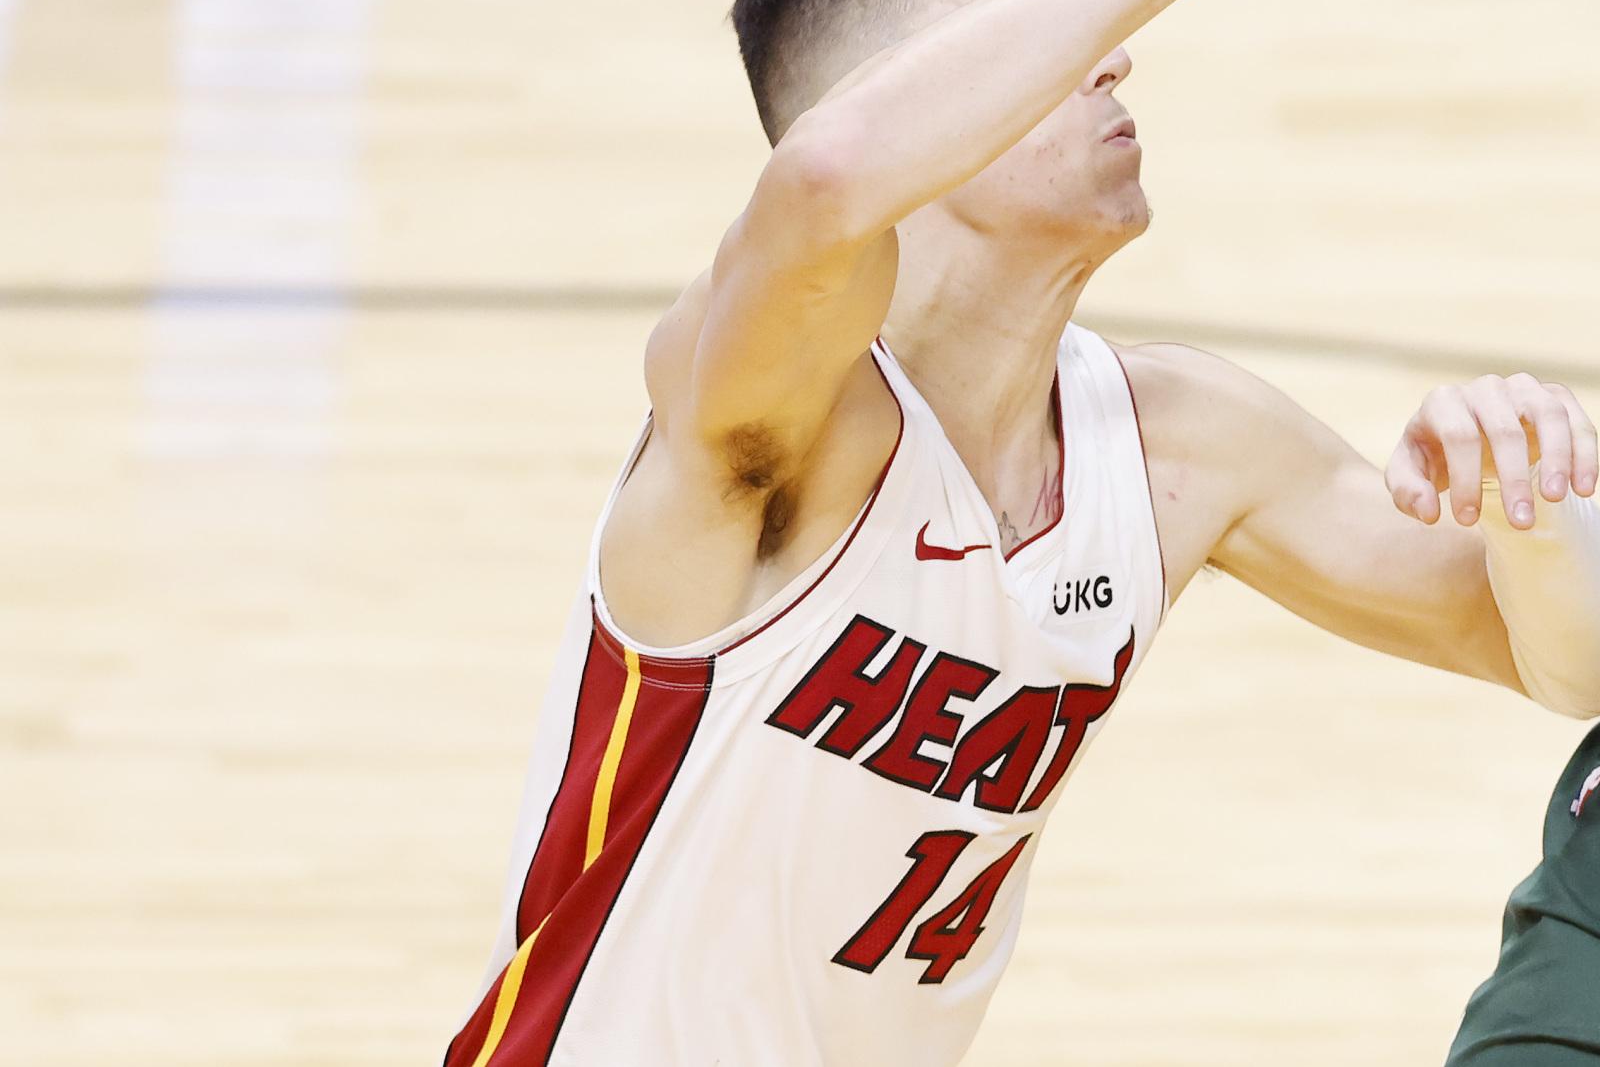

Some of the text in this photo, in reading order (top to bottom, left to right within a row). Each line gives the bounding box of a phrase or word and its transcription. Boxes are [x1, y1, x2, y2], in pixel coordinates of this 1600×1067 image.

[1053, 575, 1113, 616] UKG
[764, 614, 1135, 815] HEAT
[831, 829, 1033, 985] 14
